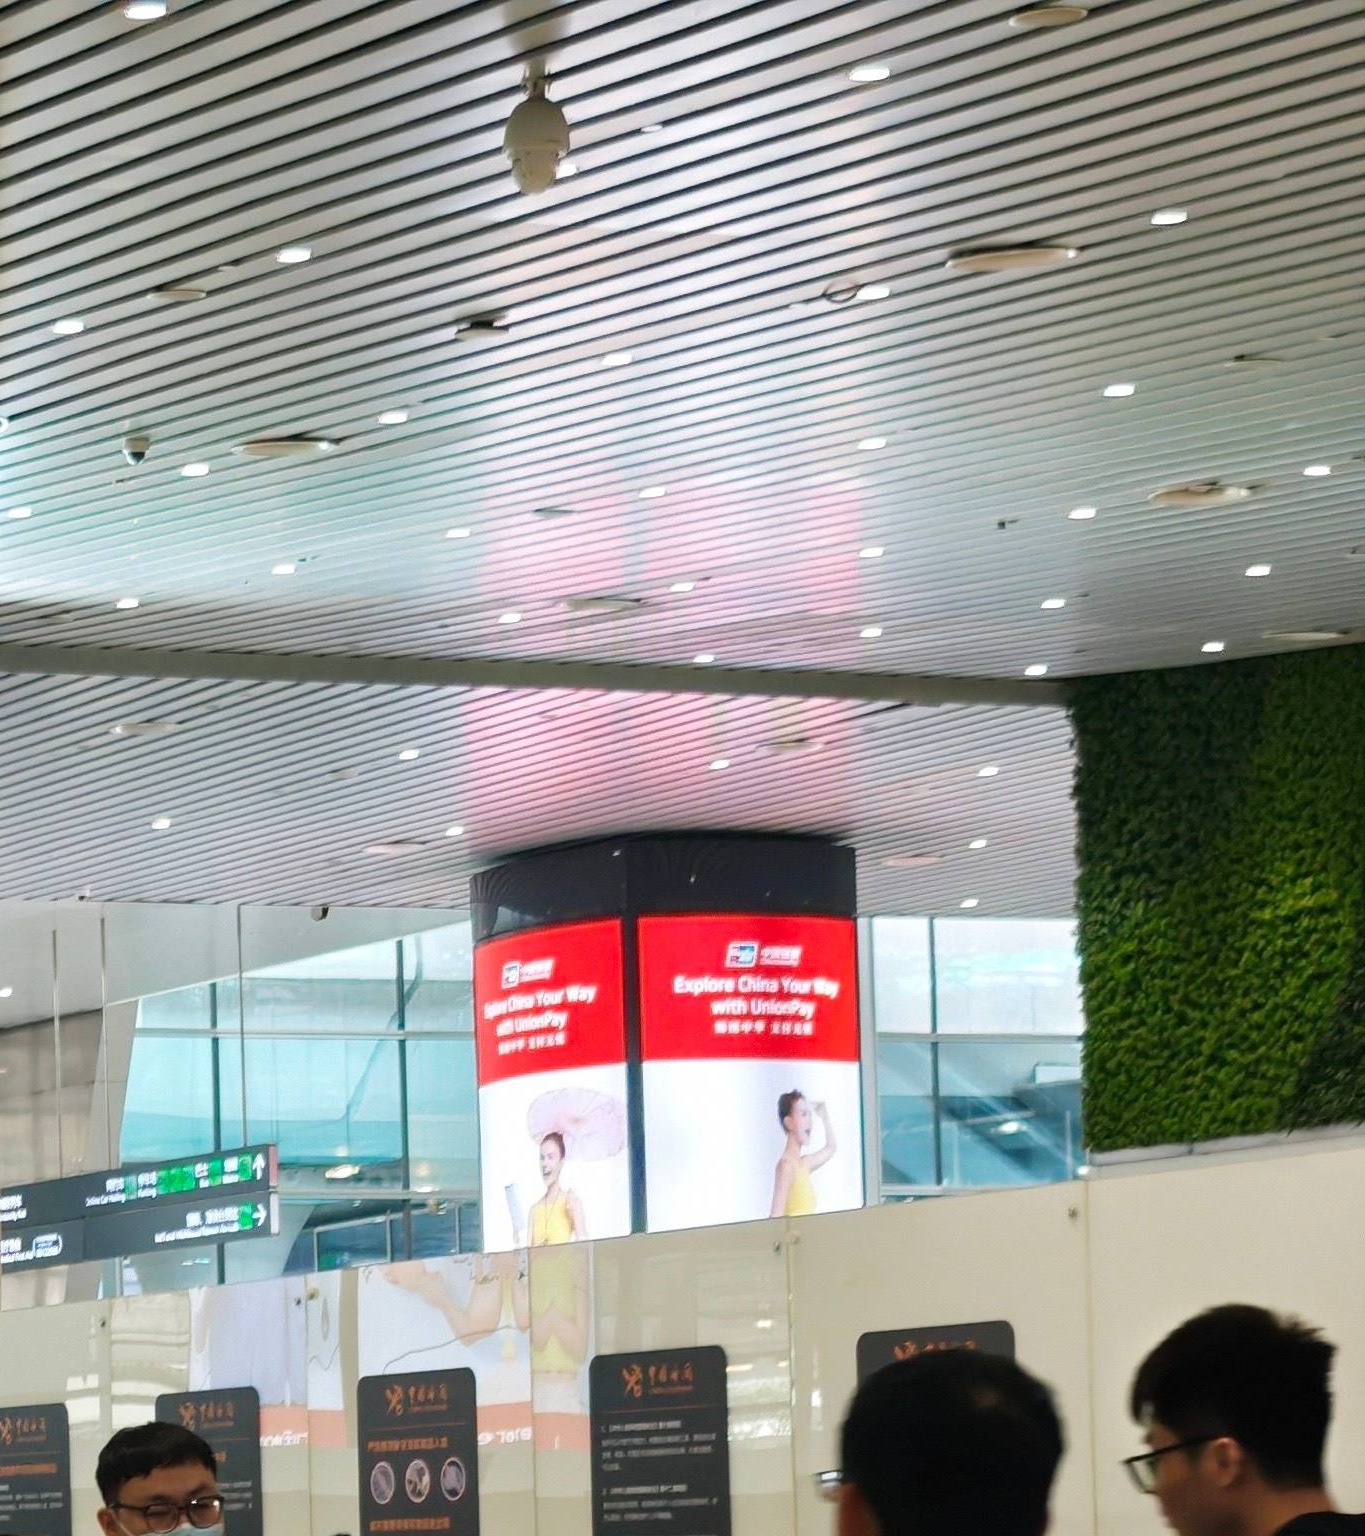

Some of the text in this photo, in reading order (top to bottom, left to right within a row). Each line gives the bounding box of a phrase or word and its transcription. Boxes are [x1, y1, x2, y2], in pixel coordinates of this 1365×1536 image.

[535, 988, 565, 1007] Your
[565, 984, 598, 1004] Way
[674, 975, 735, 996] Explore
[737, 974, 779, 993] China
[780, 976, 812, 993] Your
[711, 998, 816, 1020] with UnionPay
